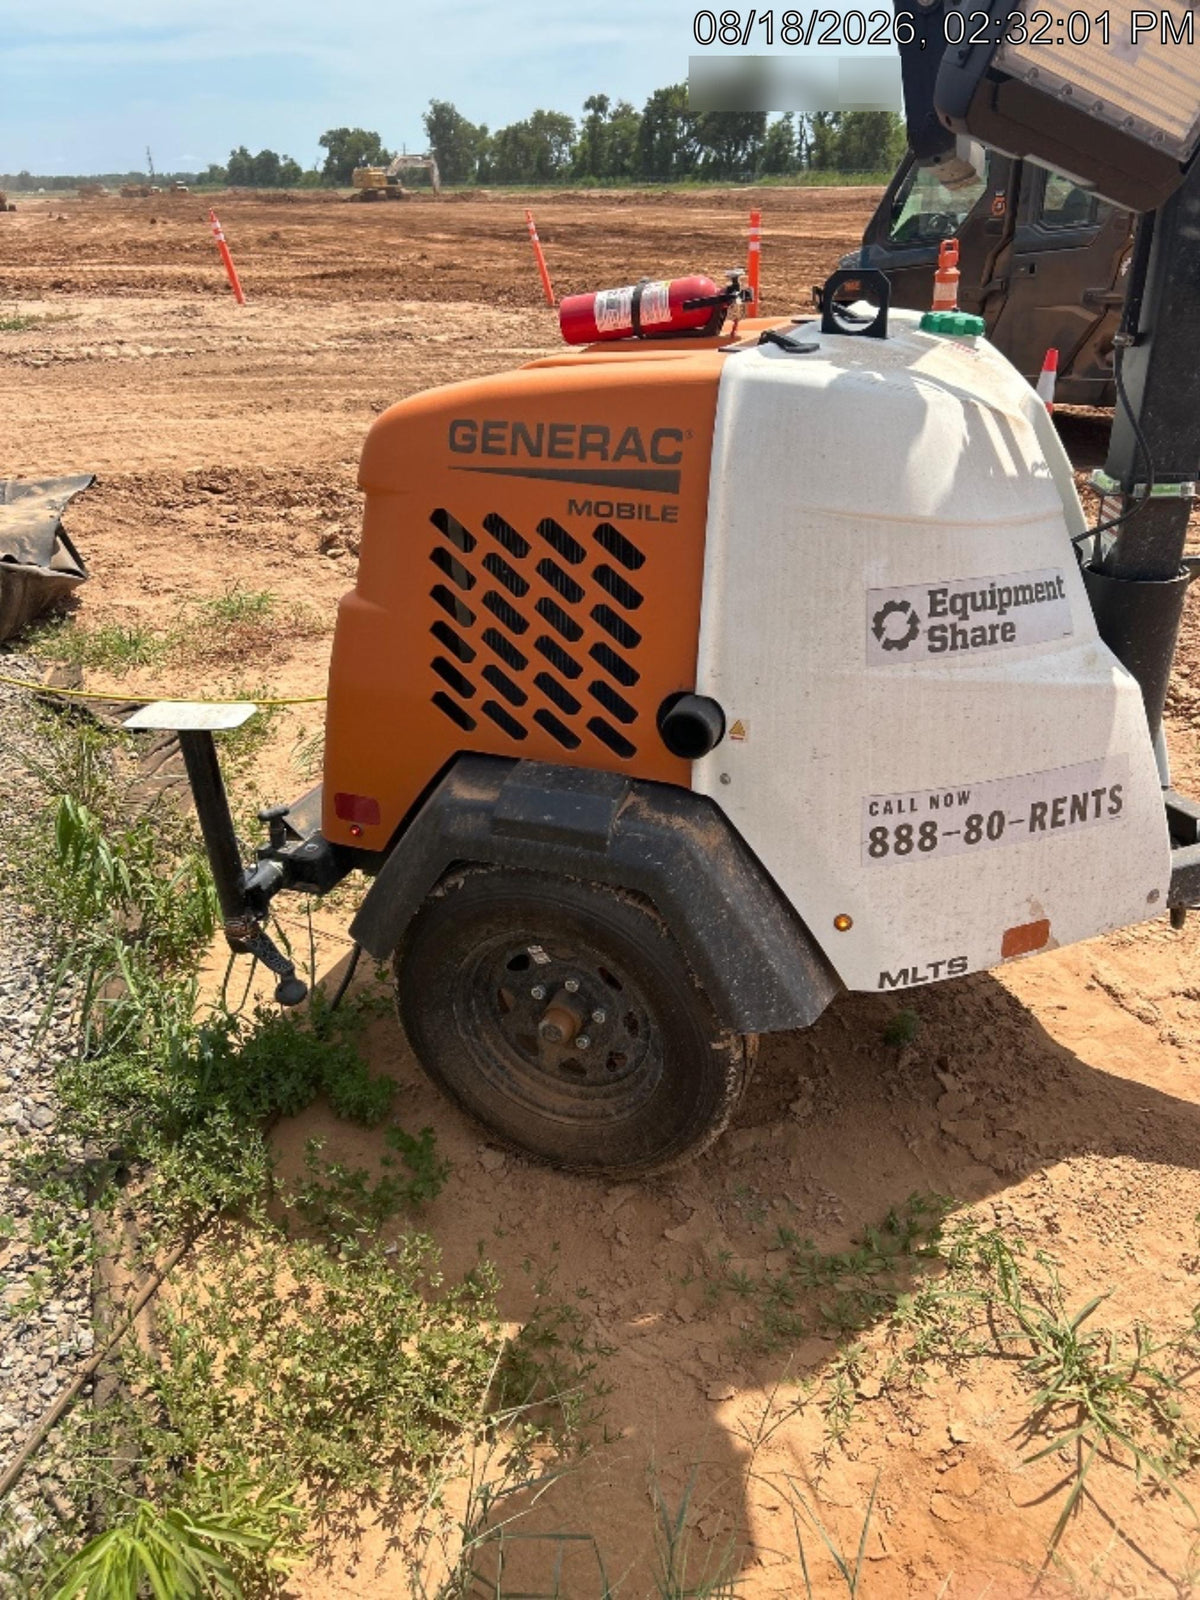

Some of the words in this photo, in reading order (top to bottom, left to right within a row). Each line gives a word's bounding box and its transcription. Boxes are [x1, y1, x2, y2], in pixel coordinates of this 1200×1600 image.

[449, 419, 684, 465] GENERAC
[567, 499, 679, 523] MOBILE
[927, 575, 1066, 621] Equipment
[927, 621, 1016, 653] Share
[868, 798, 918, 816] CALL
[929, 790, 971, 809] NOW
[868, 784, 1123, 858] 888-80-RENTS
[878, 956, 968, 988] MLTS
